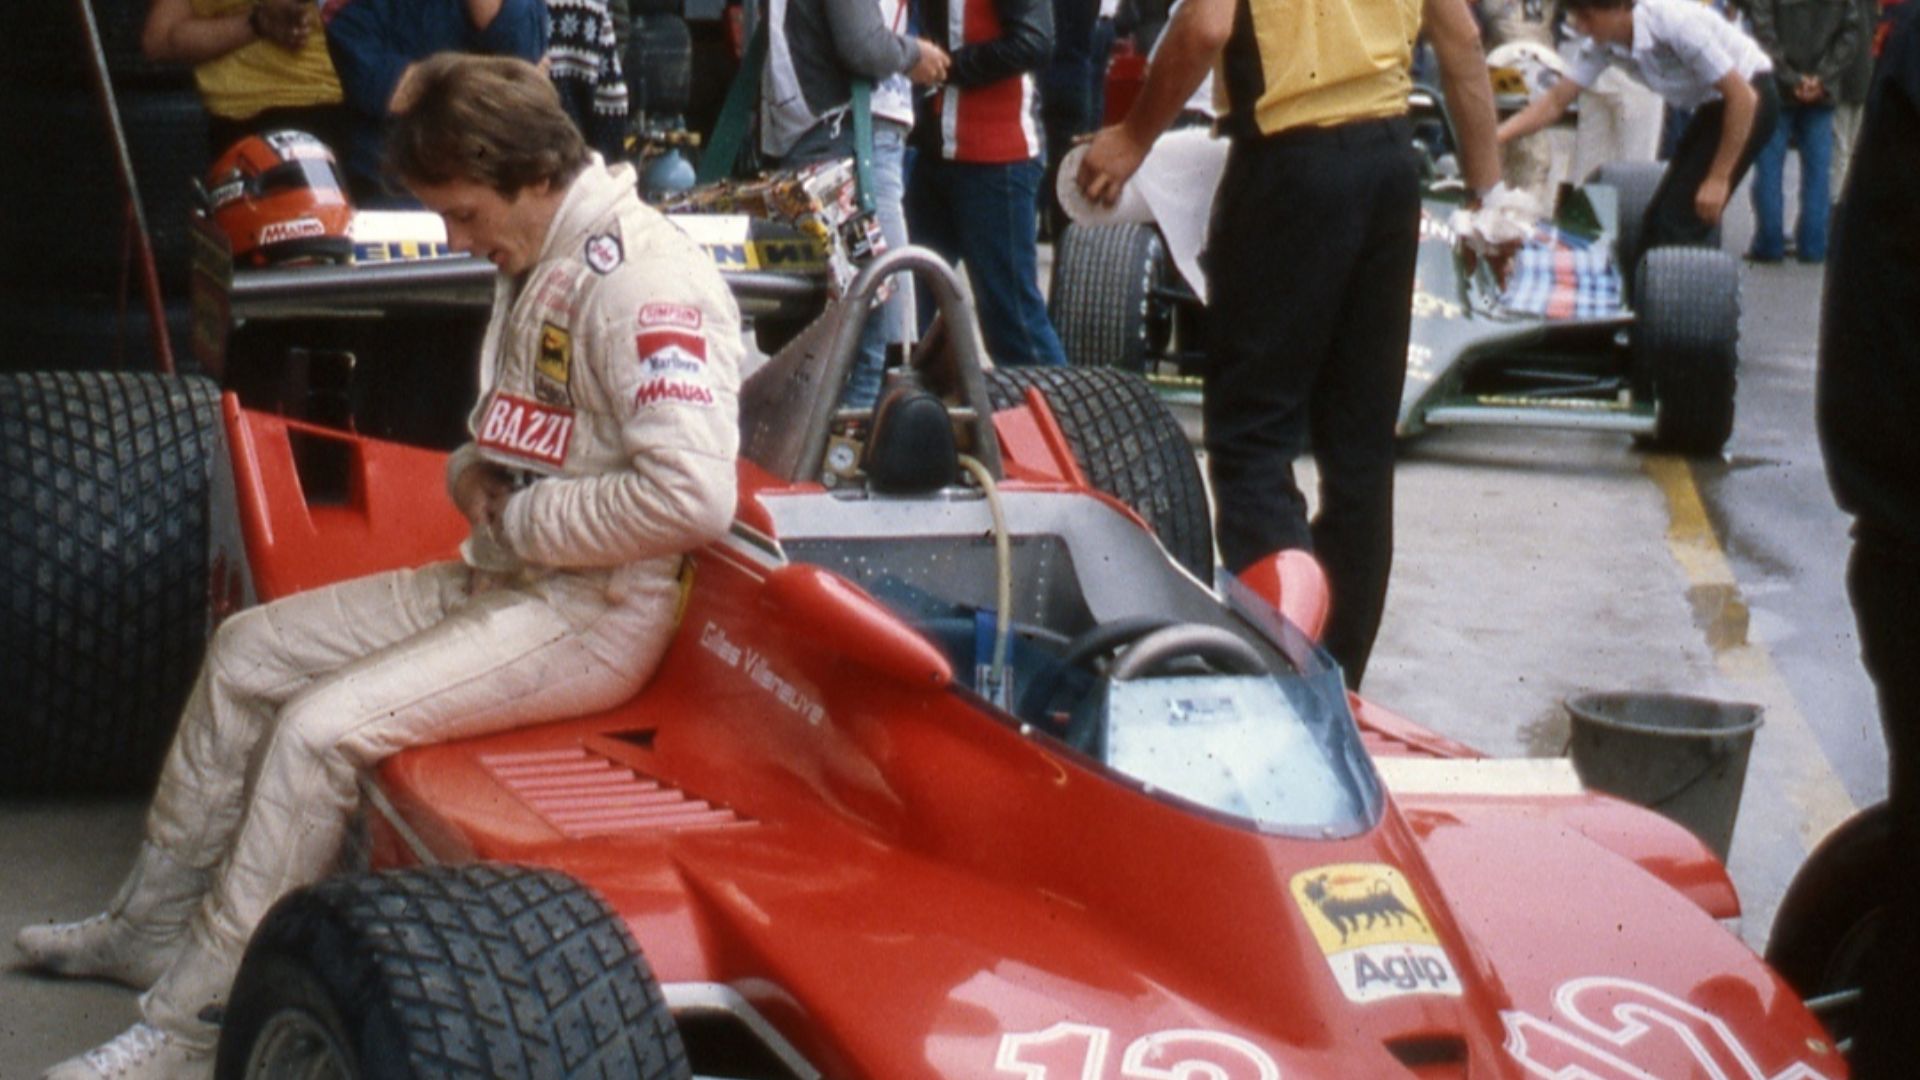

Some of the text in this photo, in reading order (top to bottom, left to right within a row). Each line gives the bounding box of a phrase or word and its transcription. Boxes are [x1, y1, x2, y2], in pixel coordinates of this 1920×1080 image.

[648, 352, 699, 373] Marlboro
[483, 399, 572, 458] BAZZI
[700, 620, 825, 726] Gilles Villeneuve
[1353, 947, 1447, 989] Agip
